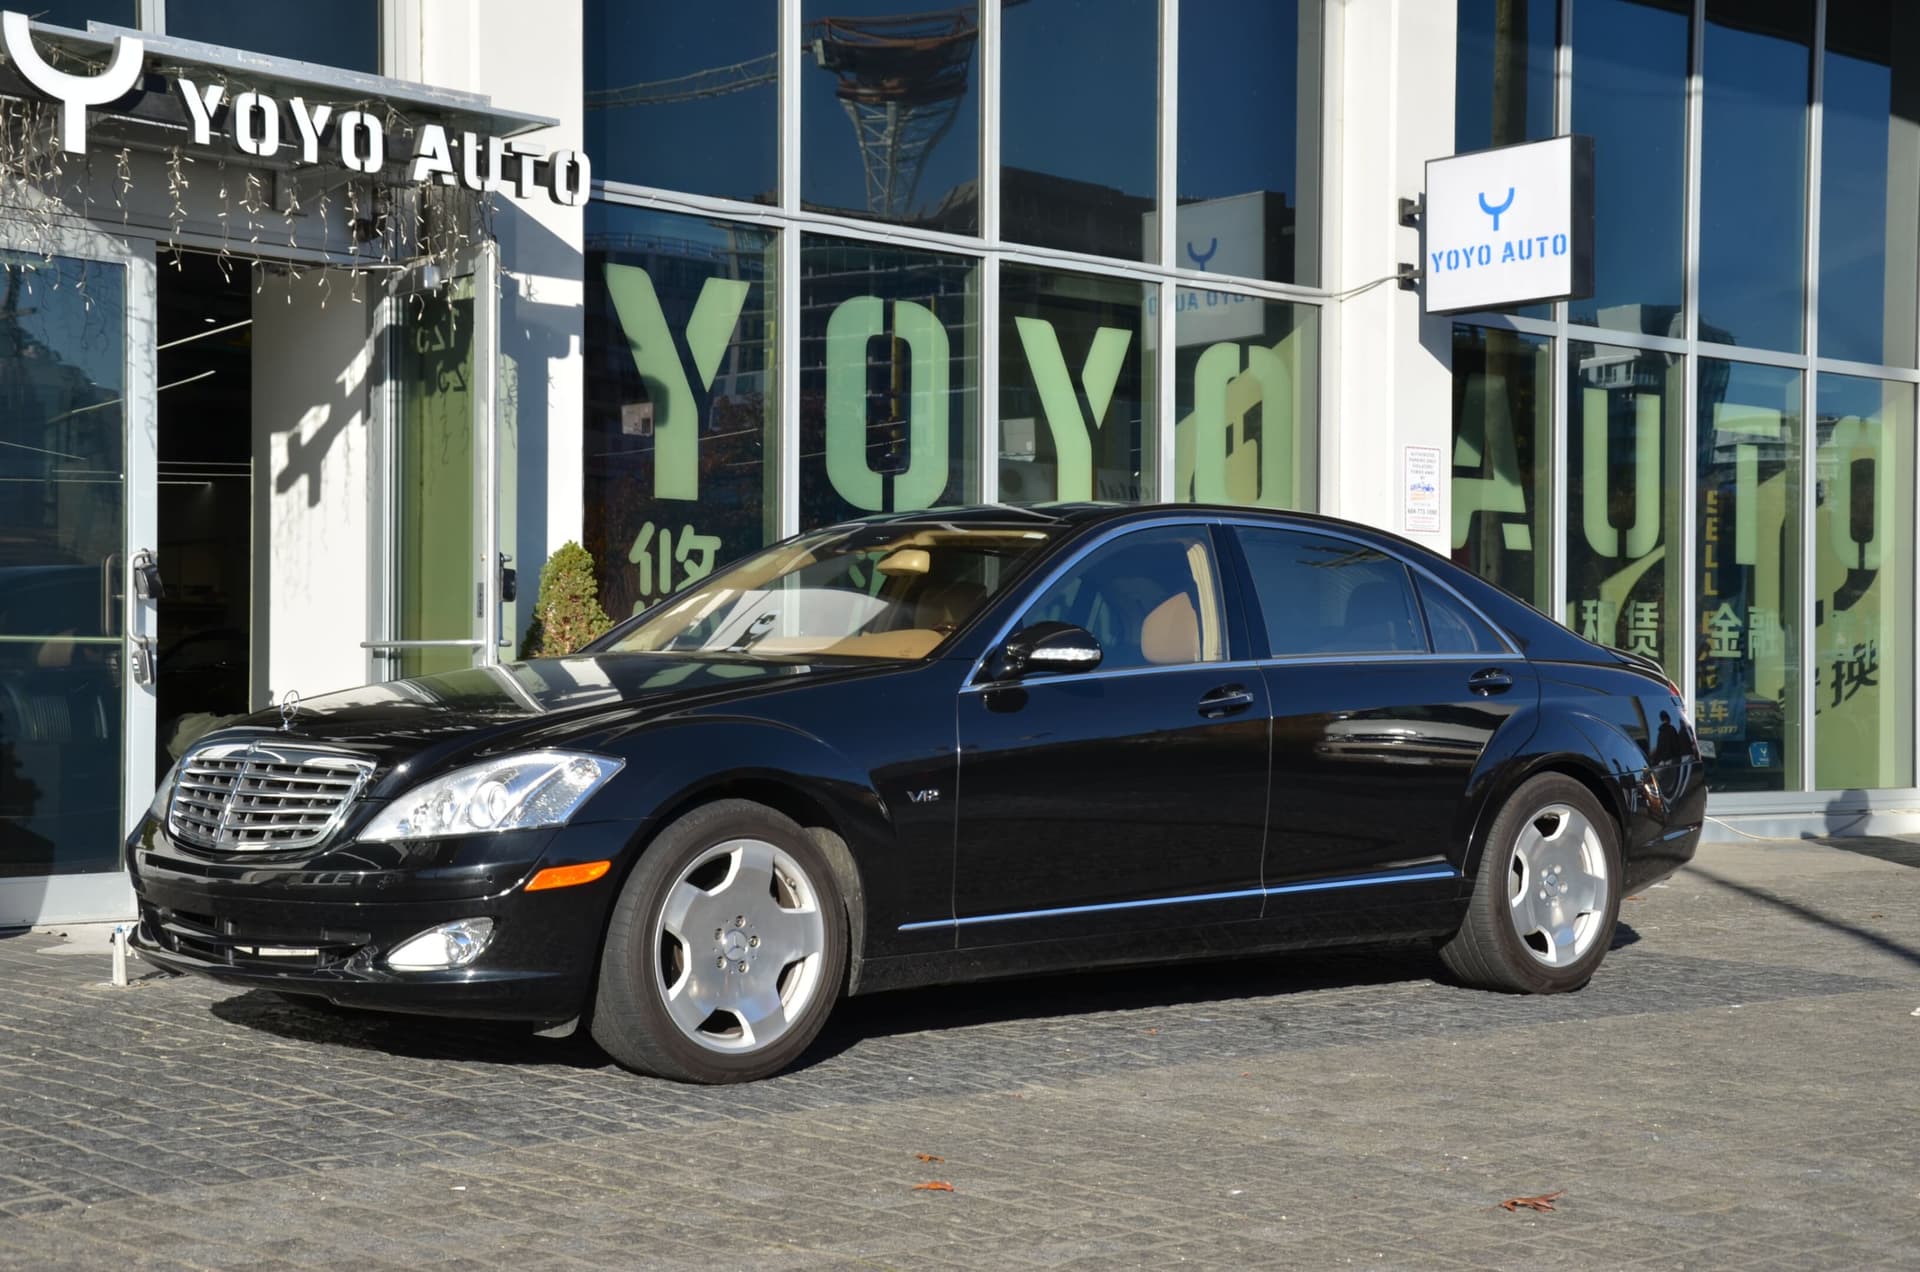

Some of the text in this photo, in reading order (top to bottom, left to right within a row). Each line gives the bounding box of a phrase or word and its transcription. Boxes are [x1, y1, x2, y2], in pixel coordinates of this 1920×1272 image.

[178, 78, 592, 207] YOYO AUTO
[1431, 233, 1567, 273] YOYO AUTO
[604, 263, 1293, 512] YOYO
